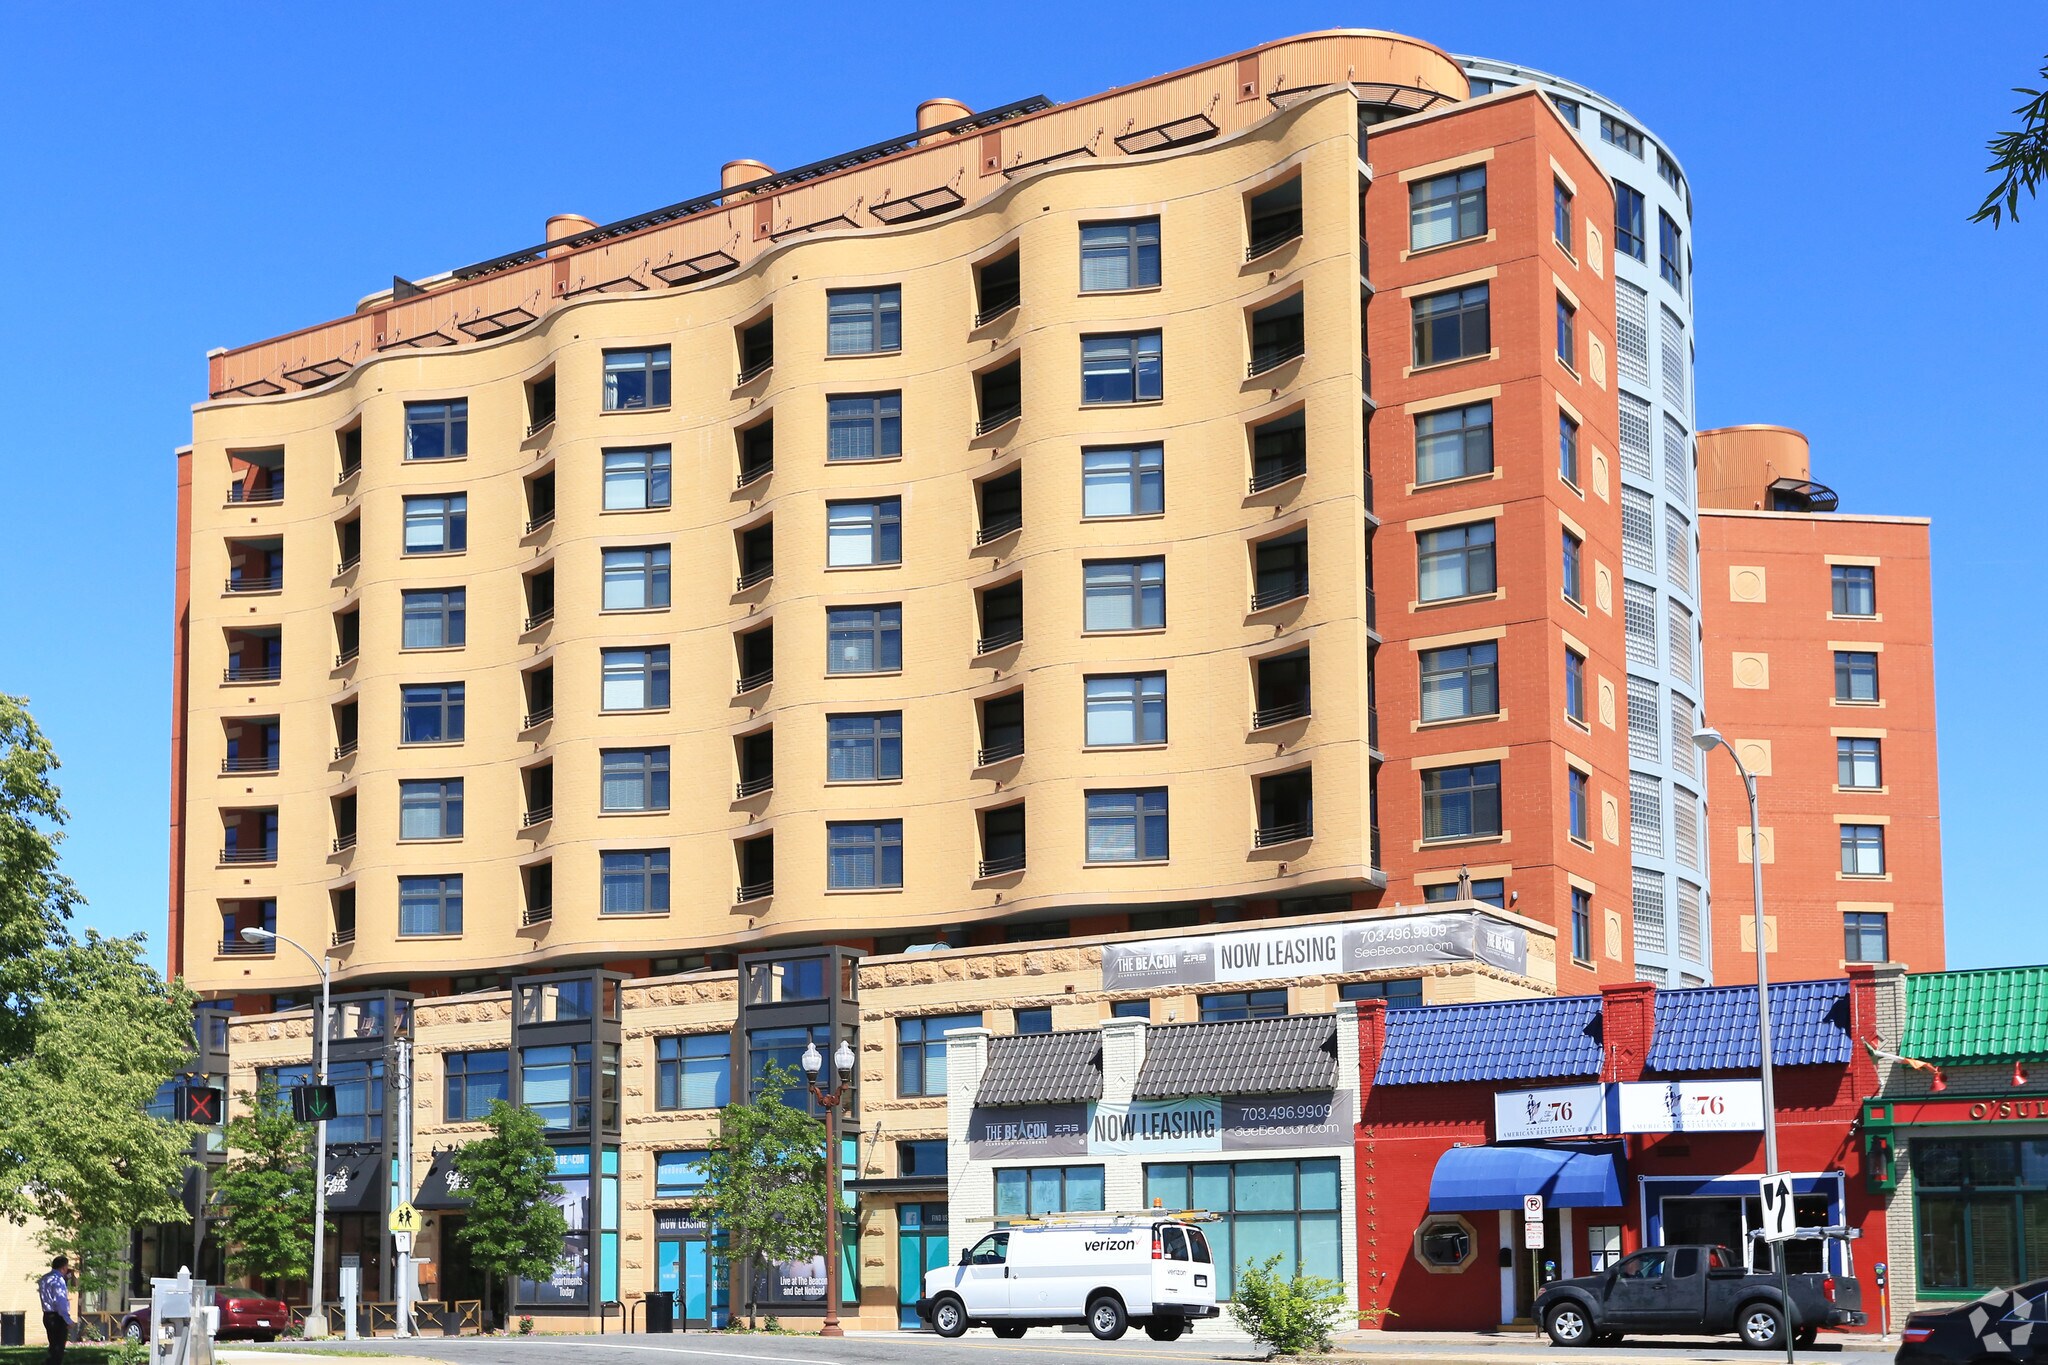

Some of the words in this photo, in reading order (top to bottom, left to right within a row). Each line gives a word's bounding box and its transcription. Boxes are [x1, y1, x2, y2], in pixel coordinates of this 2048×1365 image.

[1360, 924, 1447, 943] 703.496.9909
[1221, 942, 1261, 970] NOW
[1266, 935, 1336, 966] LEASING
[1353, 940, 1454, 958] SeeBeacon.com
[1117, 957, 1134, 972] THE
[1135, 952, 1177, 971] BEACON
[1240, 1104, 1333, 1121] 703.496.9909
[985, 1125, 1002, 1141] THE
[1004, 1119, 1047, 1140] BEACON
[1095, 1113, 1136, 1142] NOW
[1141, 1109, 1216, 1141] LEASING
[1234, 1123, 1340, 1137] SeeBeacon.com
[1676, 1121, 1727, 1129] RESTAURANT
[1503, 1130, 1534, 1138] AMERICAN
[1536, 1127, 1576, 1136] RESTAURANT
[660, 1218, 677, 1230] NOW
[678, 1217, 707, 1229] LEASING
[1084, 1237, 1135, 1251] verizon
[551, 1276, 583, 1288] Apartments
[780, 1275, 791, 1286] Live
[791, 1276, 797, 1286] at
[798, 1275, 808, 1286] The
[808, 1275, 828, 1286] Beacon
[559, 1287, 575, 1299] Today
[783, 1285, 794, 1296] and
[794, 1286, 804, 1296] Get
[804, 1285, 825, 1296] Noticed
